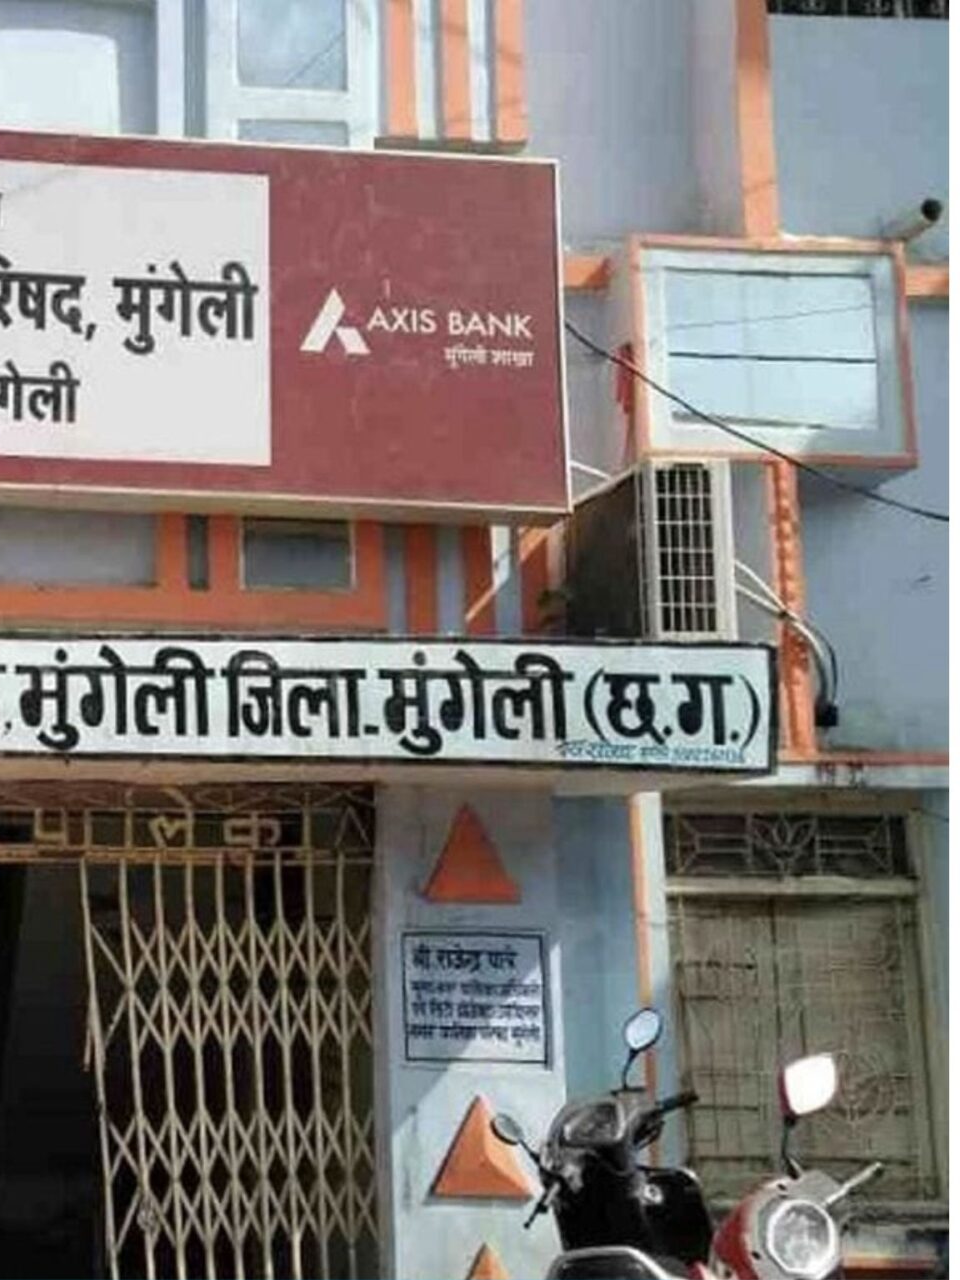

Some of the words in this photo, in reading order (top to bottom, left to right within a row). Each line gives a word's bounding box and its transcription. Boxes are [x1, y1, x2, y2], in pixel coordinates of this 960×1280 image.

[112, 260, 259, 355] मुंगेली
[366, 307, 437, 334] AXIS
[447, 310, 533, 339] BANK
[15, 646, 214, 751] मुंगेली
